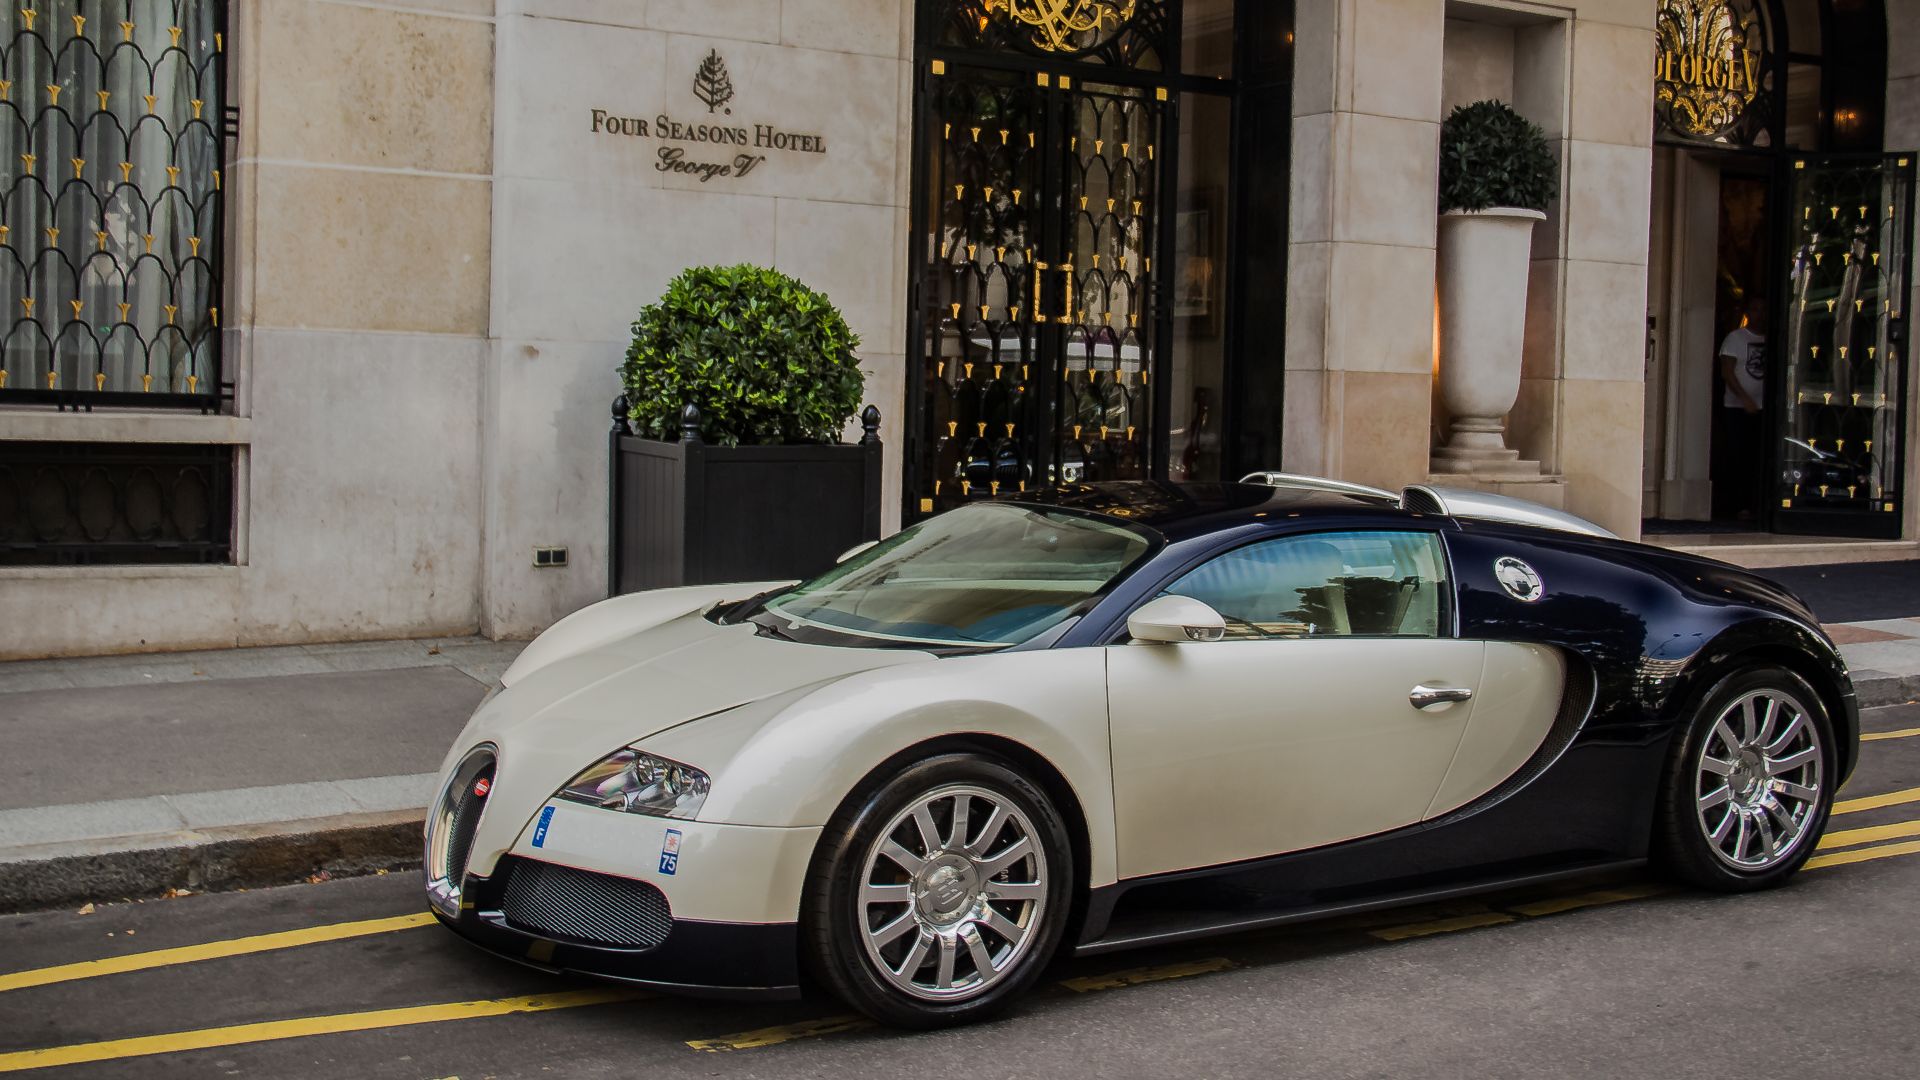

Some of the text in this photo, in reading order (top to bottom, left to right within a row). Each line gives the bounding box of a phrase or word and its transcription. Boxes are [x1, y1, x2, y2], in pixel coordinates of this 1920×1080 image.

[1741, 48, 1759, 93] V
[591, 109, 827, 153] FOUR SEASONS HOTEL
[655, 146, 766, 182] George V
[535, 827, 545, 841] F
[661, 854, 677, 872] 75
